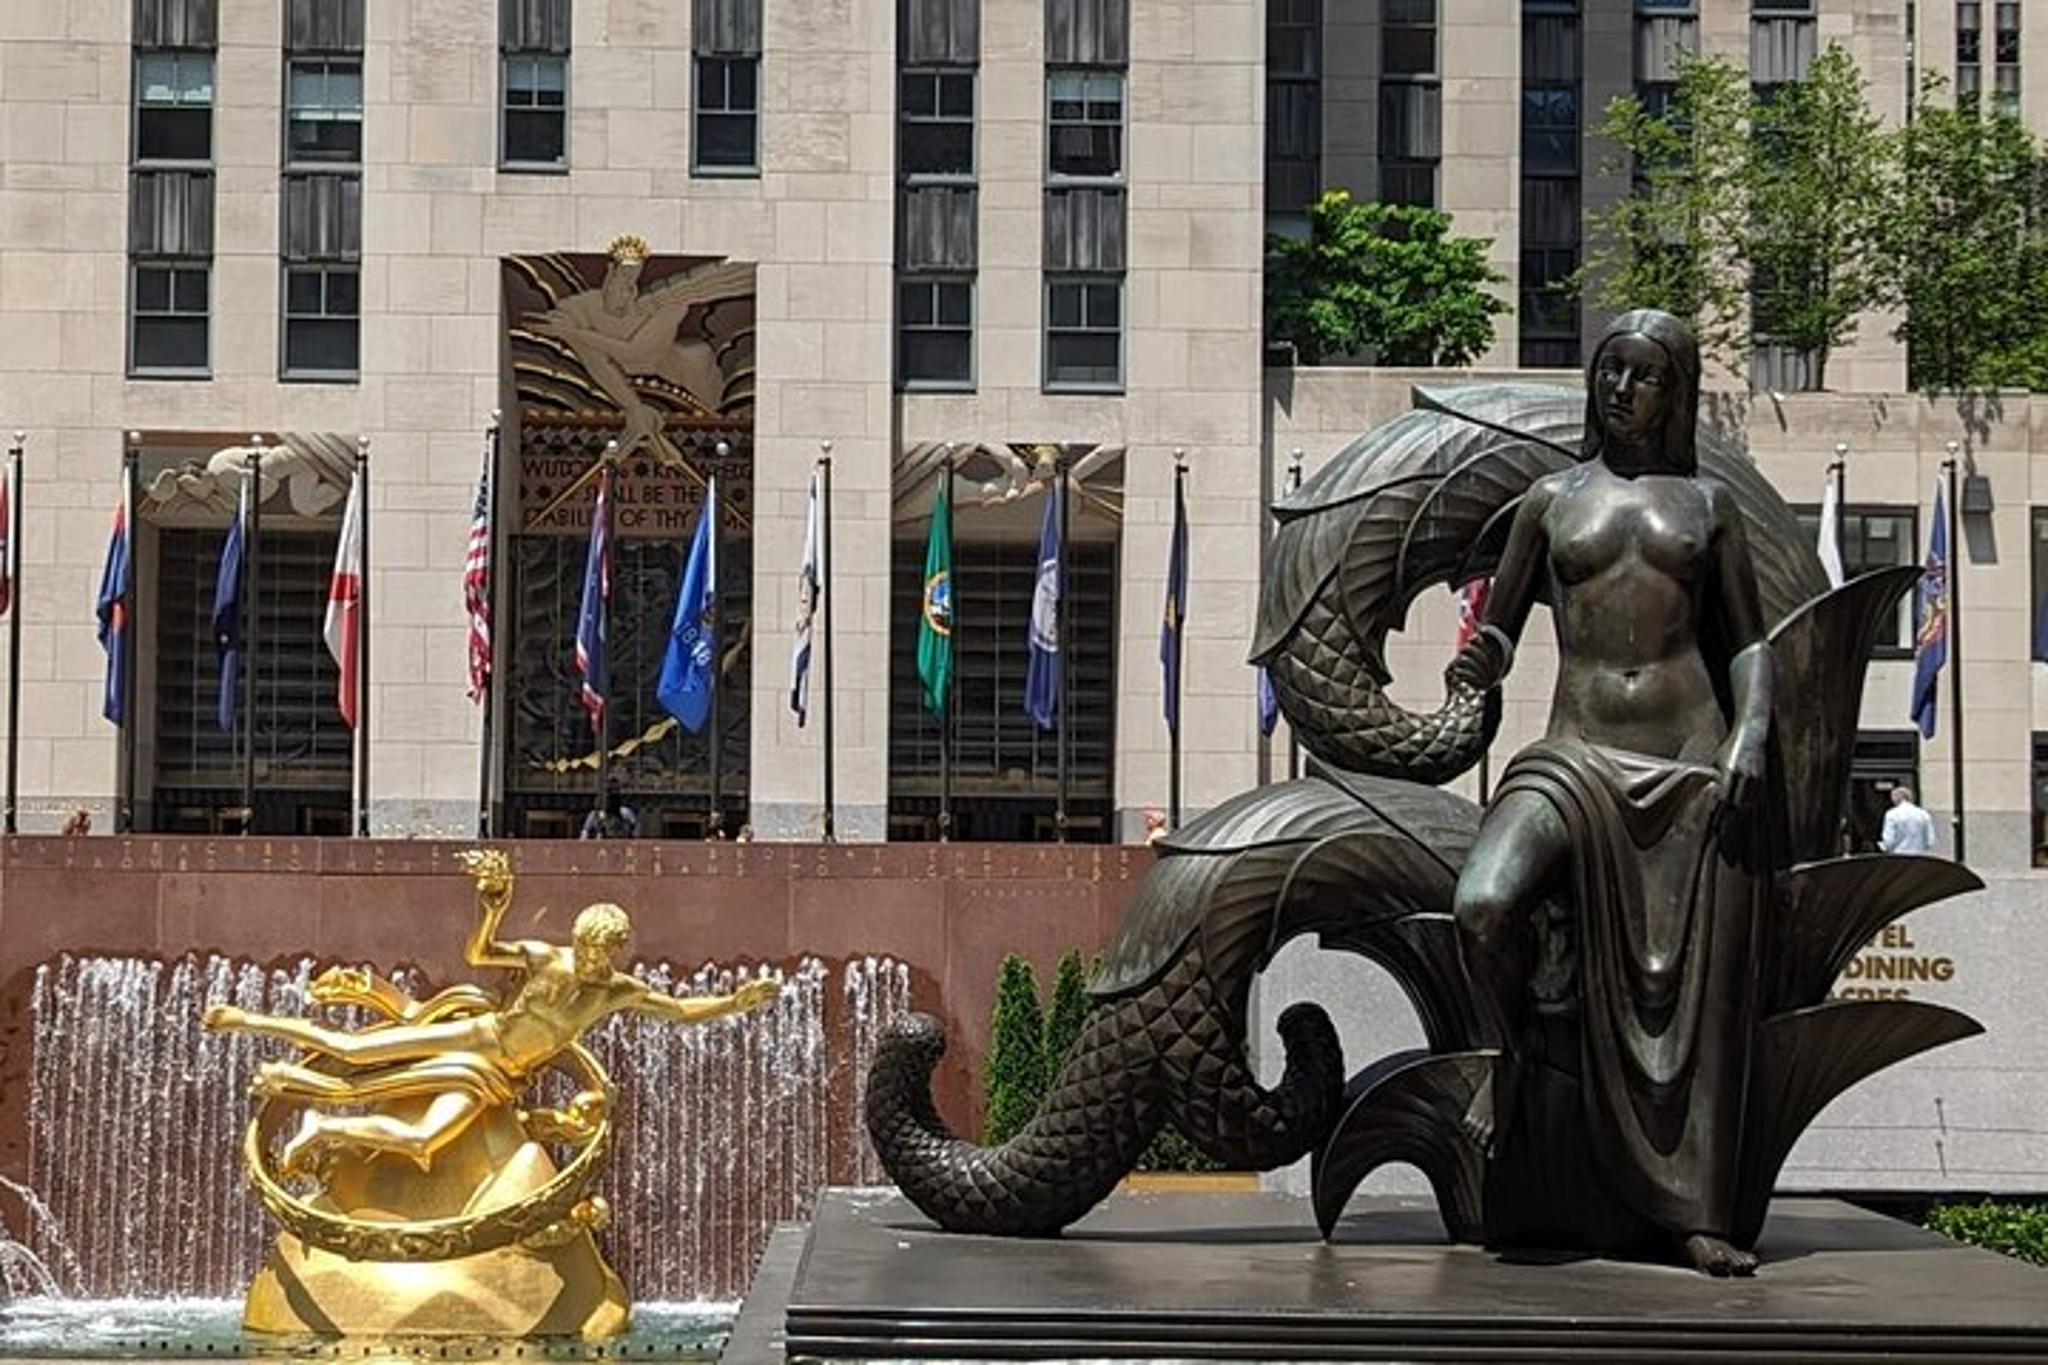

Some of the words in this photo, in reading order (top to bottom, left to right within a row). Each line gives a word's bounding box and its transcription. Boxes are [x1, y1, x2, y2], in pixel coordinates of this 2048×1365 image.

[643, 486, 664, 503] BE
[620, 508, 648, 527] OF
[655, 508, 694, 528] THY
[1843, 956, 1955, 982] DINING
